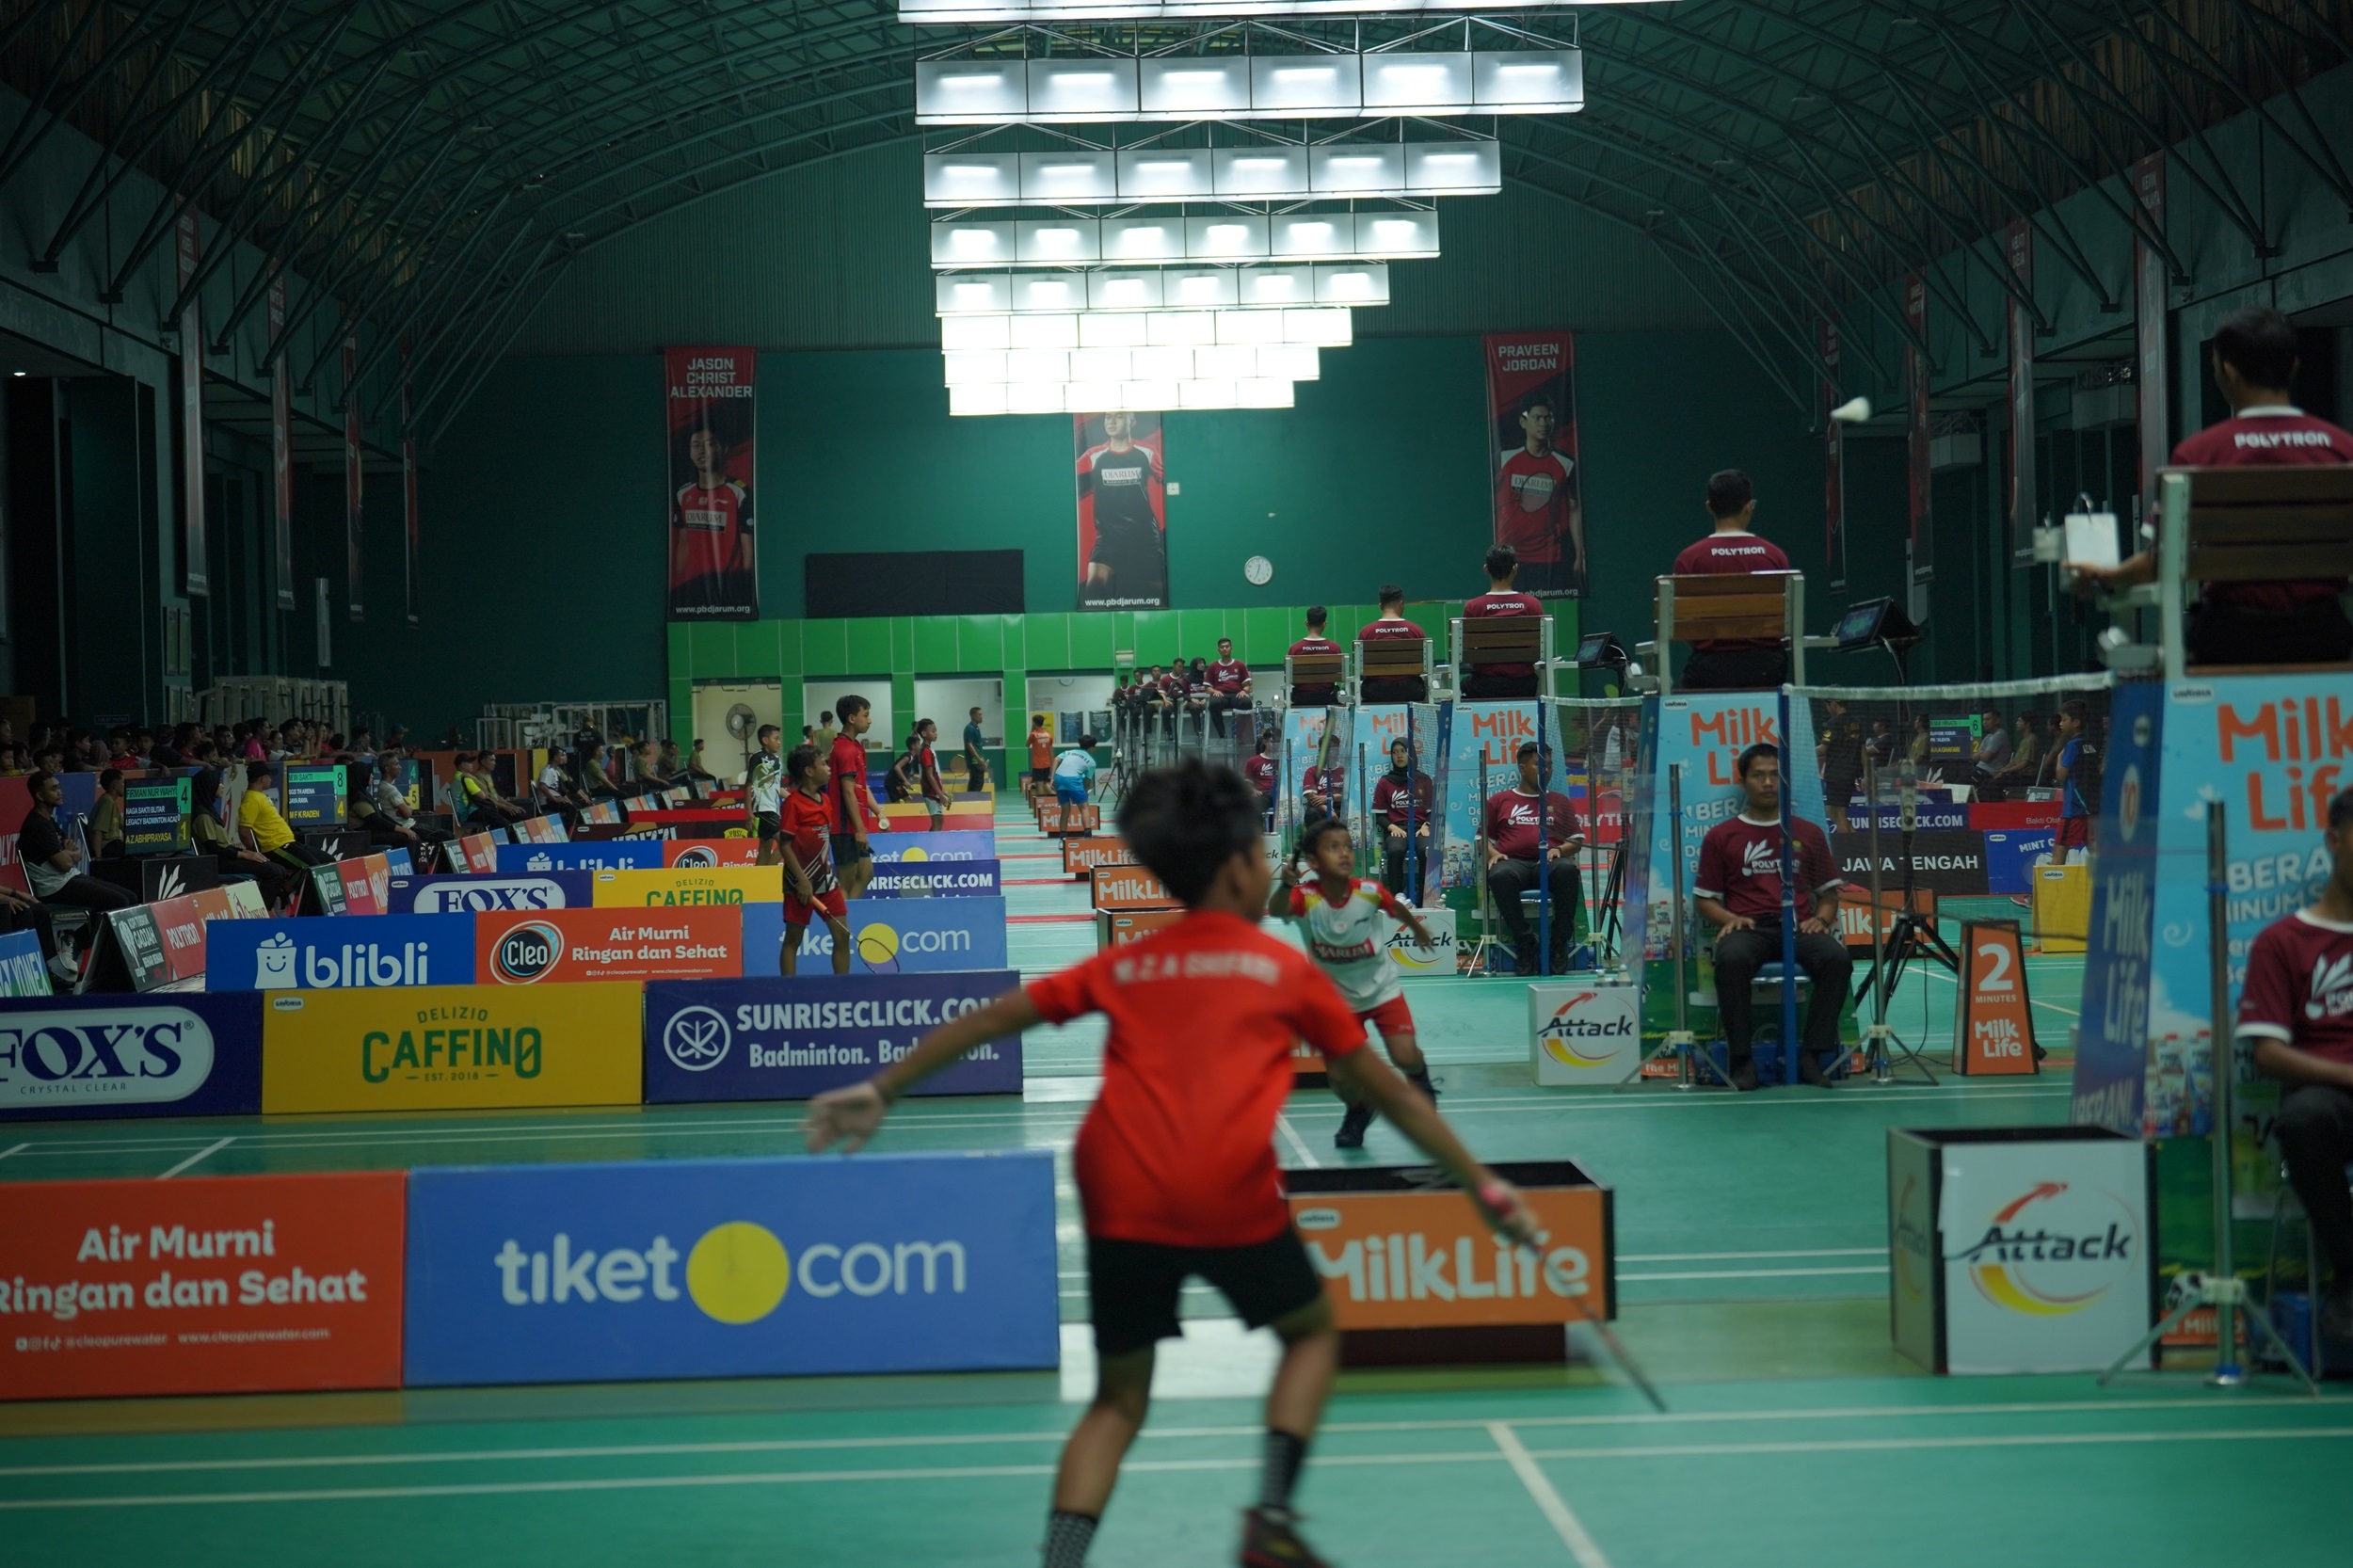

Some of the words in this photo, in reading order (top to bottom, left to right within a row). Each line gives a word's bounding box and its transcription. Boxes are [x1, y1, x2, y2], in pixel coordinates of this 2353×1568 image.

[1498, 344, 1560, 358] PRAVEEN
[687, 358, 734, 371] JASON
[1502, 358, 1557, 372] JORDAN
[686, 371, 736, 384] CHRIST
[670, 385, 752, 398] ALEXANDER
[2233, 430, 2331, 449] POLYTRON
[1104, 470, 1139, 479] DJARUM
[1711, 546, 1766, 556] POLYTRON
[1085, 597, 1160, 607] www.pbdjarum.org
[1517, 587, 1578, 599] .pbdjarum.org
[675, 604, 751, 614] www.pbdjarum.org
[1472, 710, 1536, 738] Milk
[1690, 708, 1780, 746] Milk
[2217, 696, 2353, 764] Milk
[1483, 737, 1523, 765] Lif
[1707, 750, 1741, 786] Li
[337, 772, 344, 788] 8
[126, 789, 147, 798] FIRMAN
[147, 788, 159, 797] NUR
[181, 786, 188, 804] 4
[2248, 763, 2342, 831] Lif
[337, 801, 344, 817] 4
[125, 817, 142, 825] LEGACY
[143, 816, 168, 824] BADMINTON
[1847, 815, 1963, 829] SUNISECCK.COM
[2025, 817, 2043, 825] Bakti
[181, 822, 186, 840] 1
[2019, 840, 2047, 854] MINT
[1752, 860, 1801, 869] POLYTON
[2227, 846, 2333, 893] BERA
[675, 878, 714, 888] DELIZIO
[866, 872, 993, 890] NRISECLICK.COM
[647, 888, 744, 907] CAFFINO
[1098, 879, 1173, 902] MilkLi
[433, 887, 548, 913] FOX'S
[166, 922, 200, 950] POLYTRON
[609, 927, 635, 941] Air
[638, 925, 690, 940] Murni
[902, 929, 970, 953] com
[1387, 932, 1453, 948] Attck
[506, 940, 548, 966] Cleo
[572, 947, 633, 965] Ringan
[636, 946, 671, 960] dan
[675, 945, 728, 959] Sehat
[306, 941, 428, 987] blibli
[1977, 943, 2013, 992] 2
[9, 951, 54, 997] YONEX
[274, 1000, 303, 1008] SAVORIA
[1975, 994, 2017, 1004] MINUTES
[417, 1007, 488, 1024] DELIZIO
[1539, 1015, 1633, 1037] Attack
[1975, 1017, 2020, 1040] Milk
[361, 1025, 542, 1083] CAFFINO
[749, 1040, 872, 1069] Badminton.
[1983, 1038, 2023, 1058] Life
[424, 1071, 448, 1082] EST.
[450, 1070, 480, 1081] 2018
[20, 1084, 80, 1096] CRYSTAL
[85, 1082, 128, 1094] CLEAR
[76, 1225, 141, 1263] Air
[148, 1220, 275, 1260] Murni
[1956, 1223, 2132, 1263] Attack
[494, 1232, 680, 1306] tiket
[796, 1239, 968, 1298] com
[1309, 1230, 1591, 1303] MilkLife
[144, 1271, 229, 1310] dan
[238, 1266, 367, 1305] Sehat
